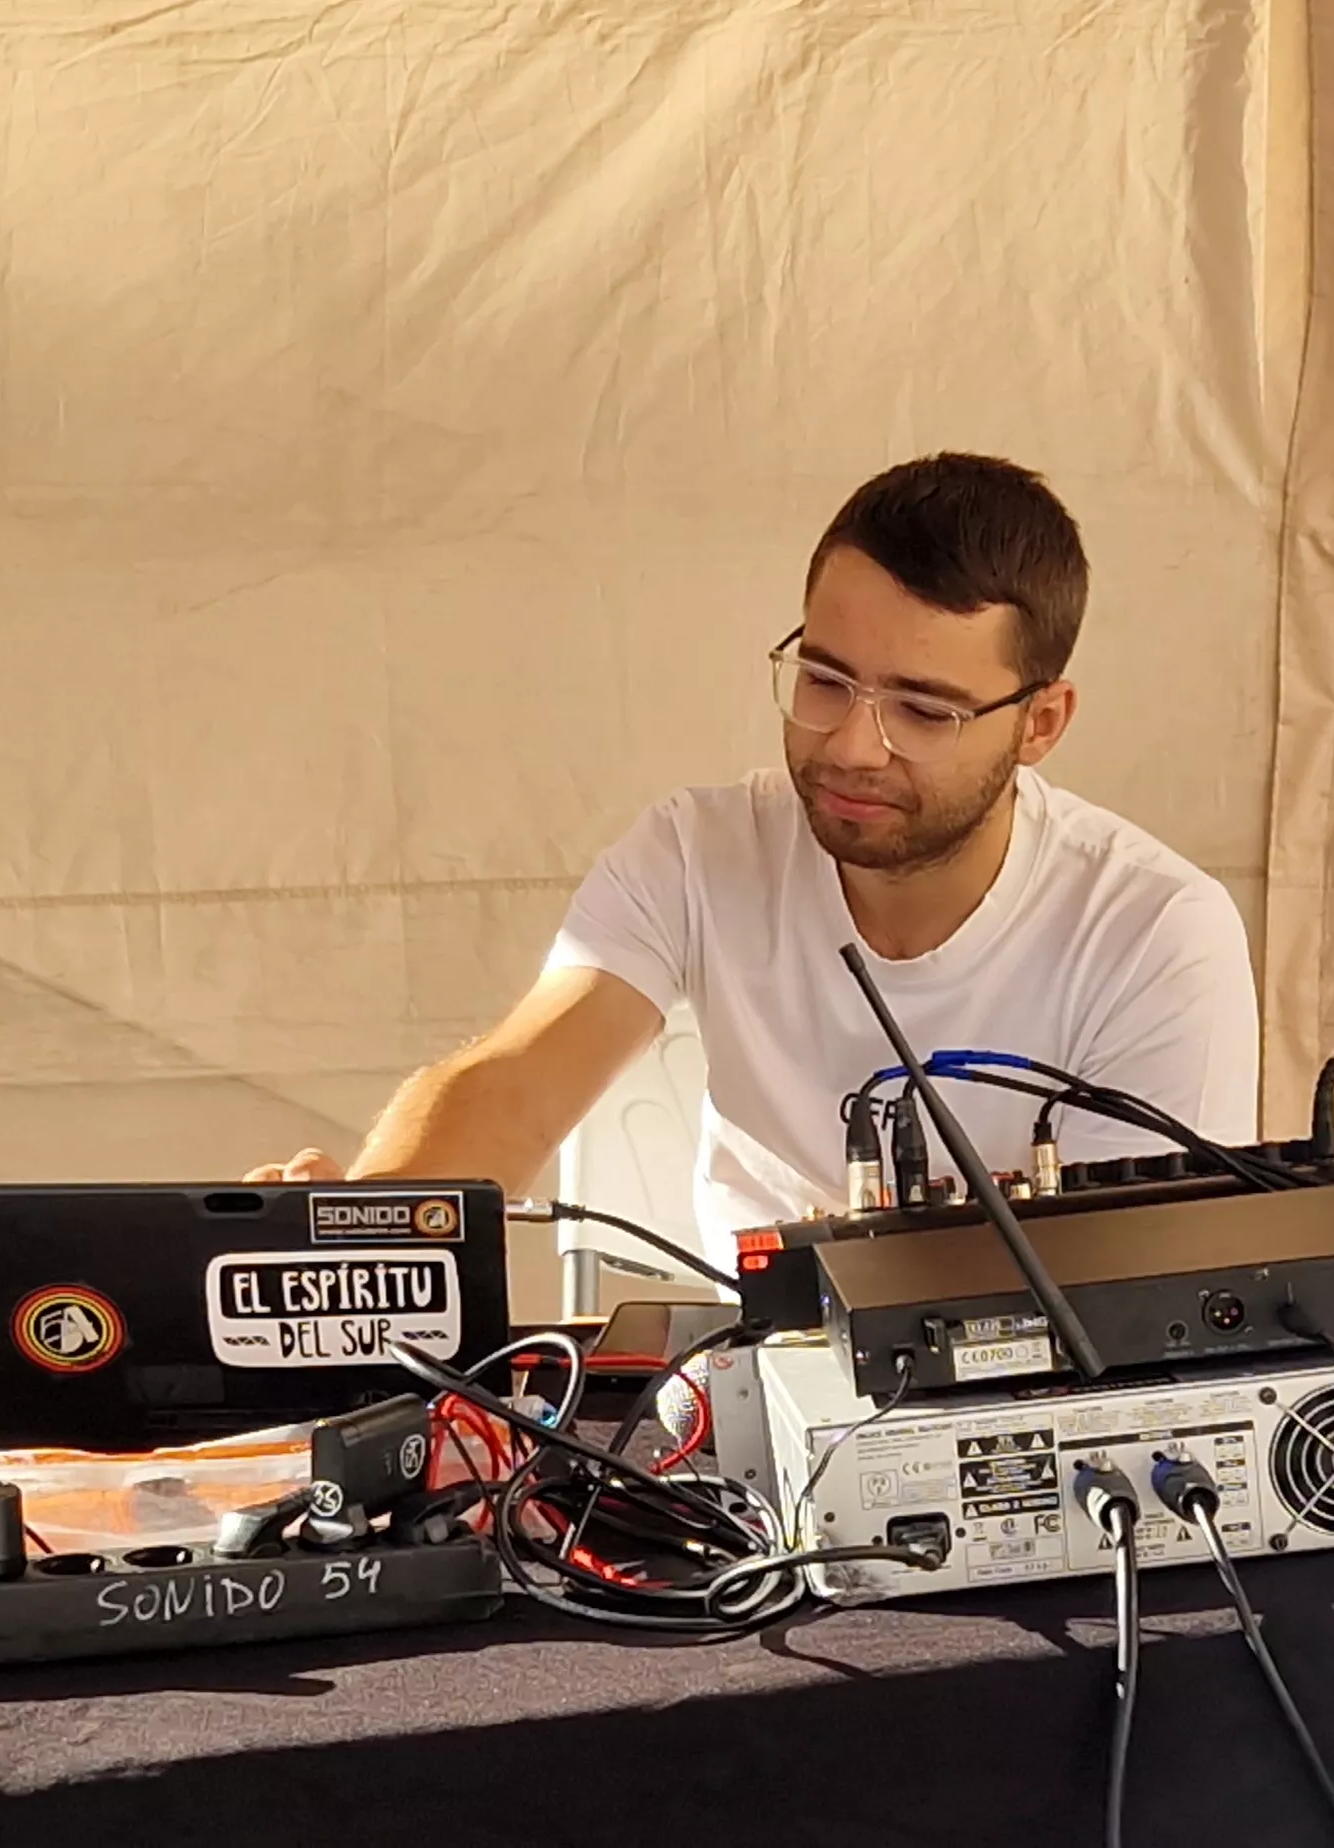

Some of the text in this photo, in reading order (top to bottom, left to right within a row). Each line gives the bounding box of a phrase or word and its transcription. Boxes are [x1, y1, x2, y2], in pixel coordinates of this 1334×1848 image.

[317, 1206, 411, 1226] SONIDO
[232, 1271, 271, 1314] EL
[278, 1318, 392, 1358] DEL SUR
